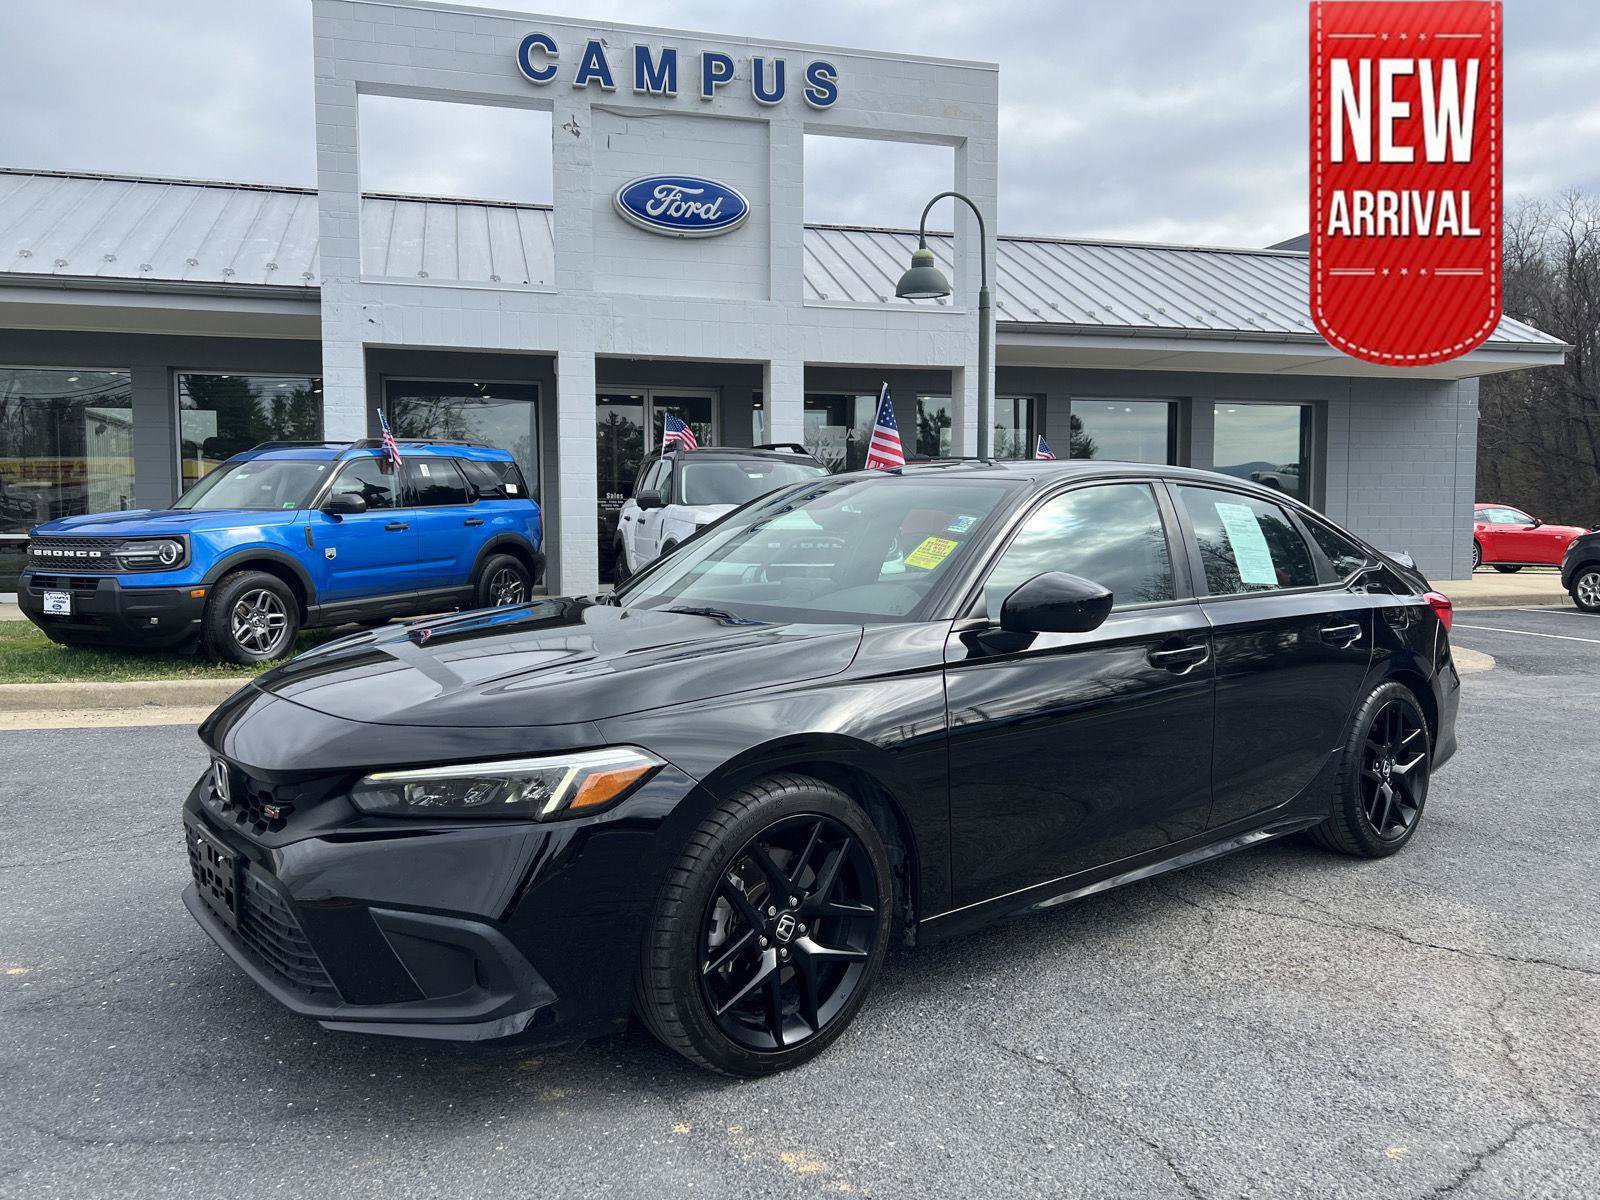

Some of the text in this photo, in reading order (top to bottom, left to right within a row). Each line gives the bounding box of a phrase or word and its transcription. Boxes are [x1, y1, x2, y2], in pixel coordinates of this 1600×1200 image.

[517, 32, 839, 109] CAMPUS
[645, 184, 724, 221] Ford
[34, 549, 101, 557] BRONCO
